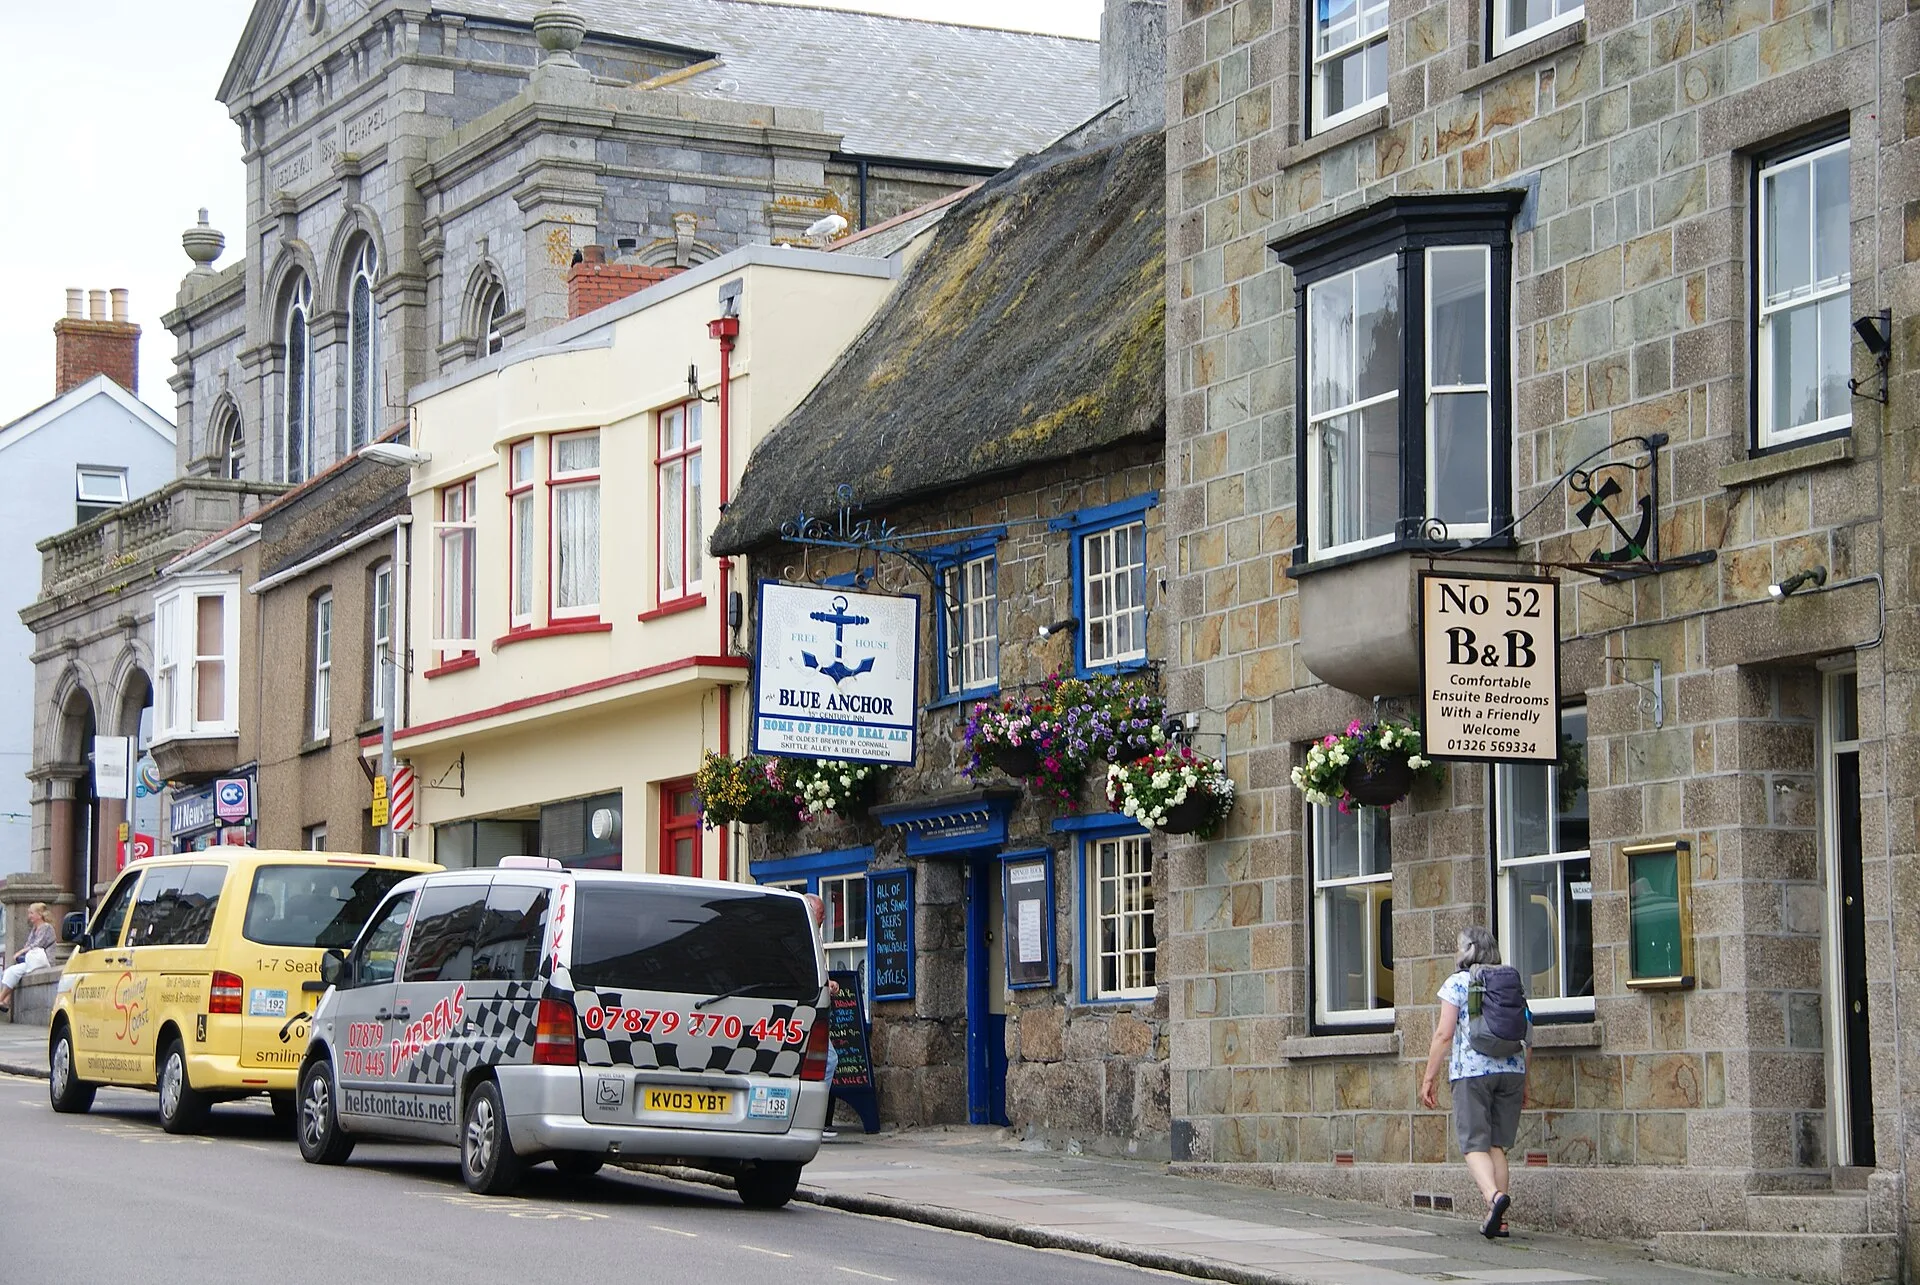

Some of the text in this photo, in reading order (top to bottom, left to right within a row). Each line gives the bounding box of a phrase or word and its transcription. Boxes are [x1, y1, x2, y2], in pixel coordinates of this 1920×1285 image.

[348, 108, 387, 146] CHAPEL
[1438, 583, 1540, 617] No 52
[791, 633, 889, 649] FREE HOUSE
[1444, 626, 1536, 668] B&B
[1450, 674, 1531, 688] Comfortable
[779, 688, 821, 709] BLUE
[826, 693, 894, 715] ANCHOR
[1432, 690, 1549, 705] Ensuite Bedrooms
[819, 712, 850, 721] CENTURY
[1441, 706, 1540, 724] With a Friendly
[763, 719, 908, 742] HOME OF SPINGO REAL ALE
[1462, 723, 1520, 736] Welcome
[780, 742, 808, 750] SKITTLE
[811, 744, 831, 752] ALLEY
[863, 749, 890, 757] GARDEN
[796, 735, 818, 743] OLDEST
[820, 738, 849, 746] BREWERY
[858, 740, 888, 749] CORNWALL
[1447, 739, 1536, 753] 01326 569334
[183, 803, 204, 827] News
[877, 883, 900, 899] ALL OF
[875, 901, 888, 915] OUR
[552, 884, 569, 973] TAXI
[880, 914, 902, 928] BEERS
[883, 929, 896, 940] ARE
[877, 941, 908, 953] AVAILABLE
[256, 958, 279, 971] 1-7
[268, 1000, 284, 1009] 192
[391, 983, 465, 1077] DARRENS
[585, 1006, 680, 1036] 07879
[688, 1012, 743, 1039] 770
[750, 1017, 803, 1044] 445
[349, 1022, 384, 1048] 07879
[343, 1050, 385, 1077] 770 445
[344, 1089, 452, 1121] helstontaxis.net
[651, 1092, 727, 1110] KV03 YBT
[769, 1100, 786, 1110] 138
